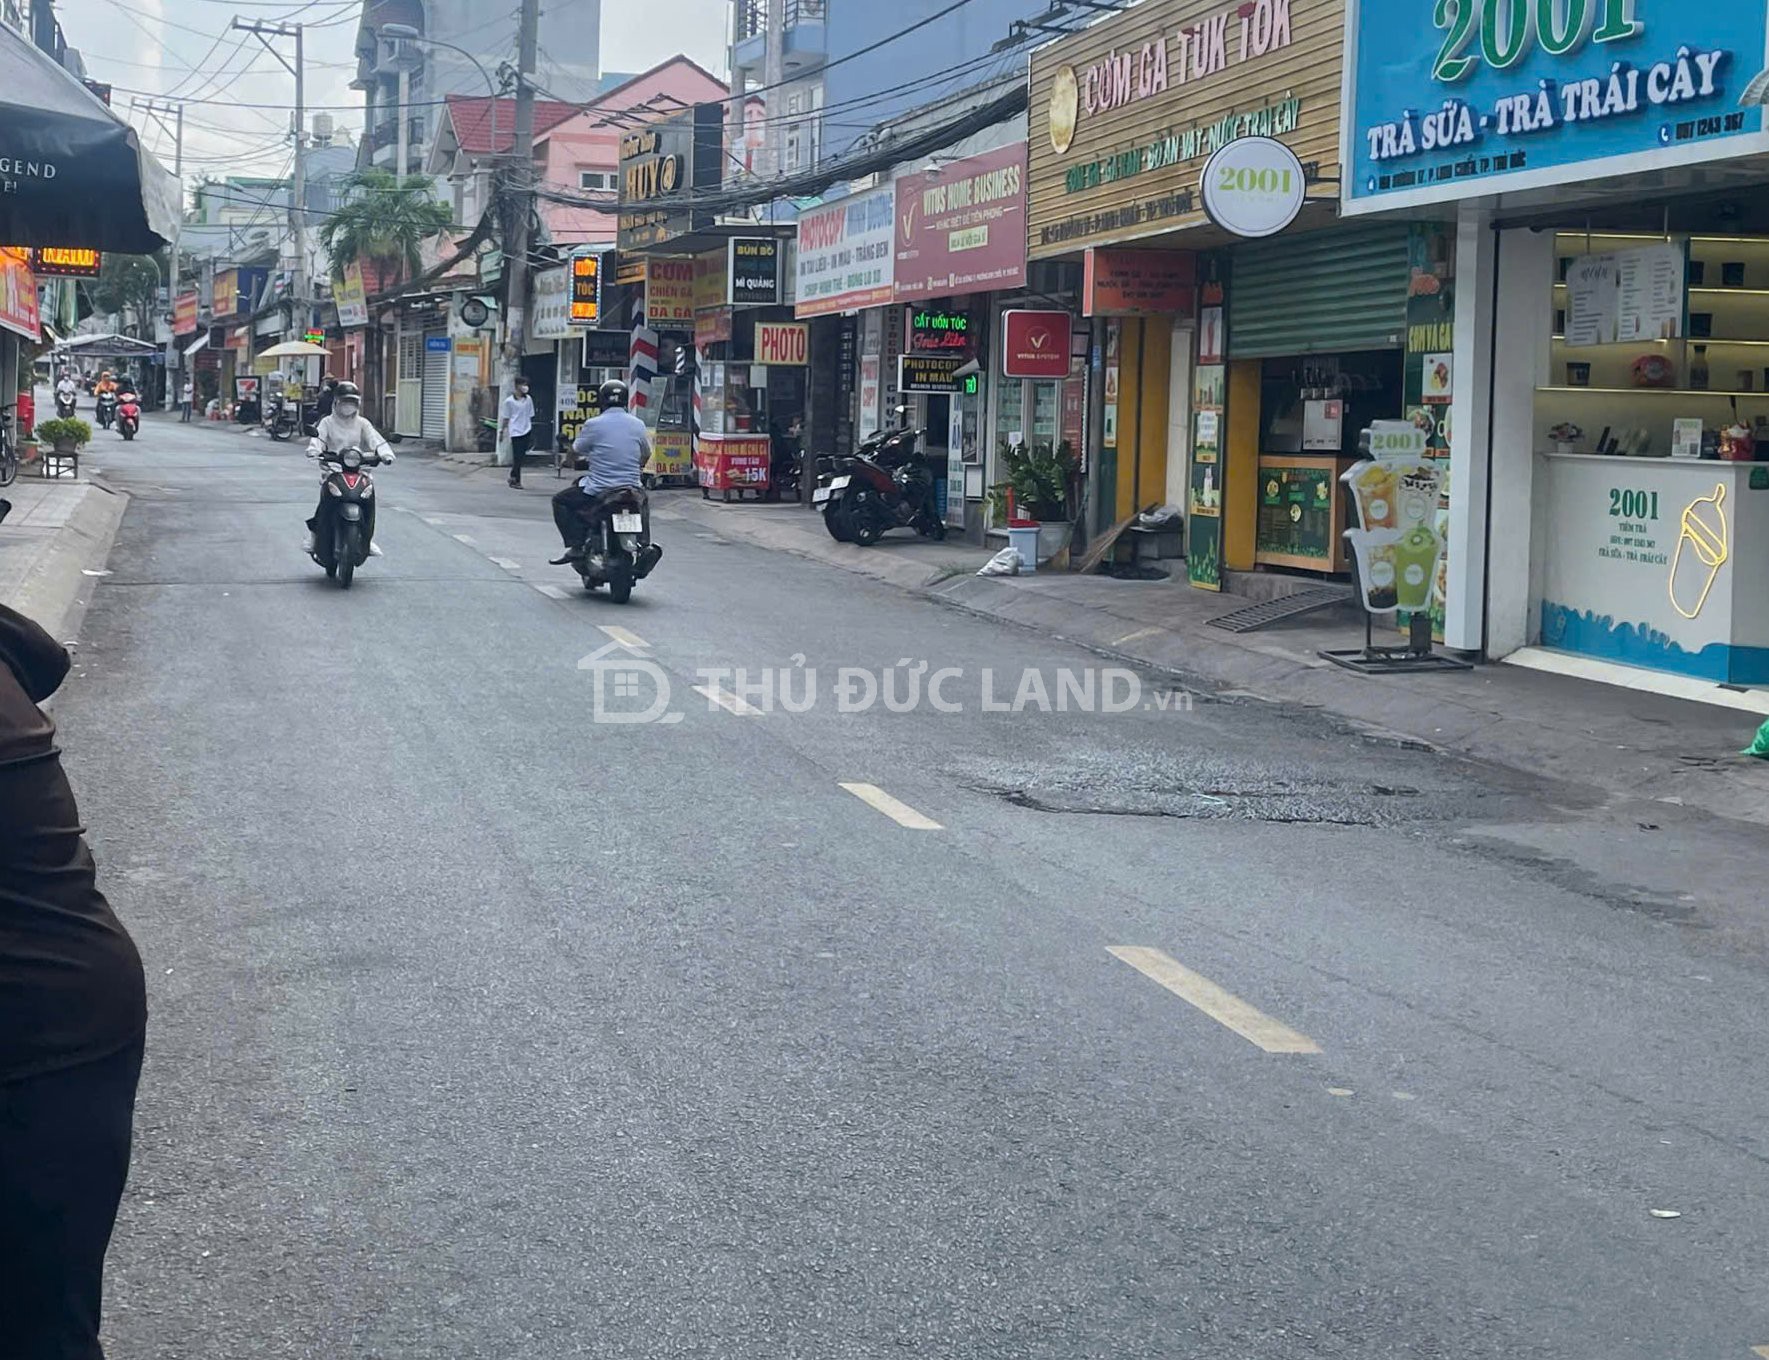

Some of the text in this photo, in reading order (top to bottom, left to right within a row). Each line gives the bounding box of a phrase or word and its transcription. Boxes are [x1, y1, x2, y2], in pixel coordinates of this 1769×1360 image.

[1178, 13, 1229, 83] TUK
[1238, 0, 1291, 61] TOK
[1432, 0, 1640, 82] 2001
[1368, 110, 1415, 160] TRÀ
[1421, 101, 1474, 149] SỮA
[1495, 79, 1553, 134] TRÀ
[1561, 62, 1639, 121] TRÁI
[1647, 46, 1722, 104] CÂY
[947, 178, 972, 211] HOME
[974, 164, 1020, 204] BUSINESS
[1218, 166, 1291, 193] 2001
[914, 312, 967, 330] CẮT UỐN TÓC
[762, 327, 805, 362] PHOTO
[904, 358, 963, 370] PHOTOCOP
[1373, 433, 1422, 450] 2001
[745, 467, 767, 482] 15K
[1609, 488, 1659, 520] 2001
